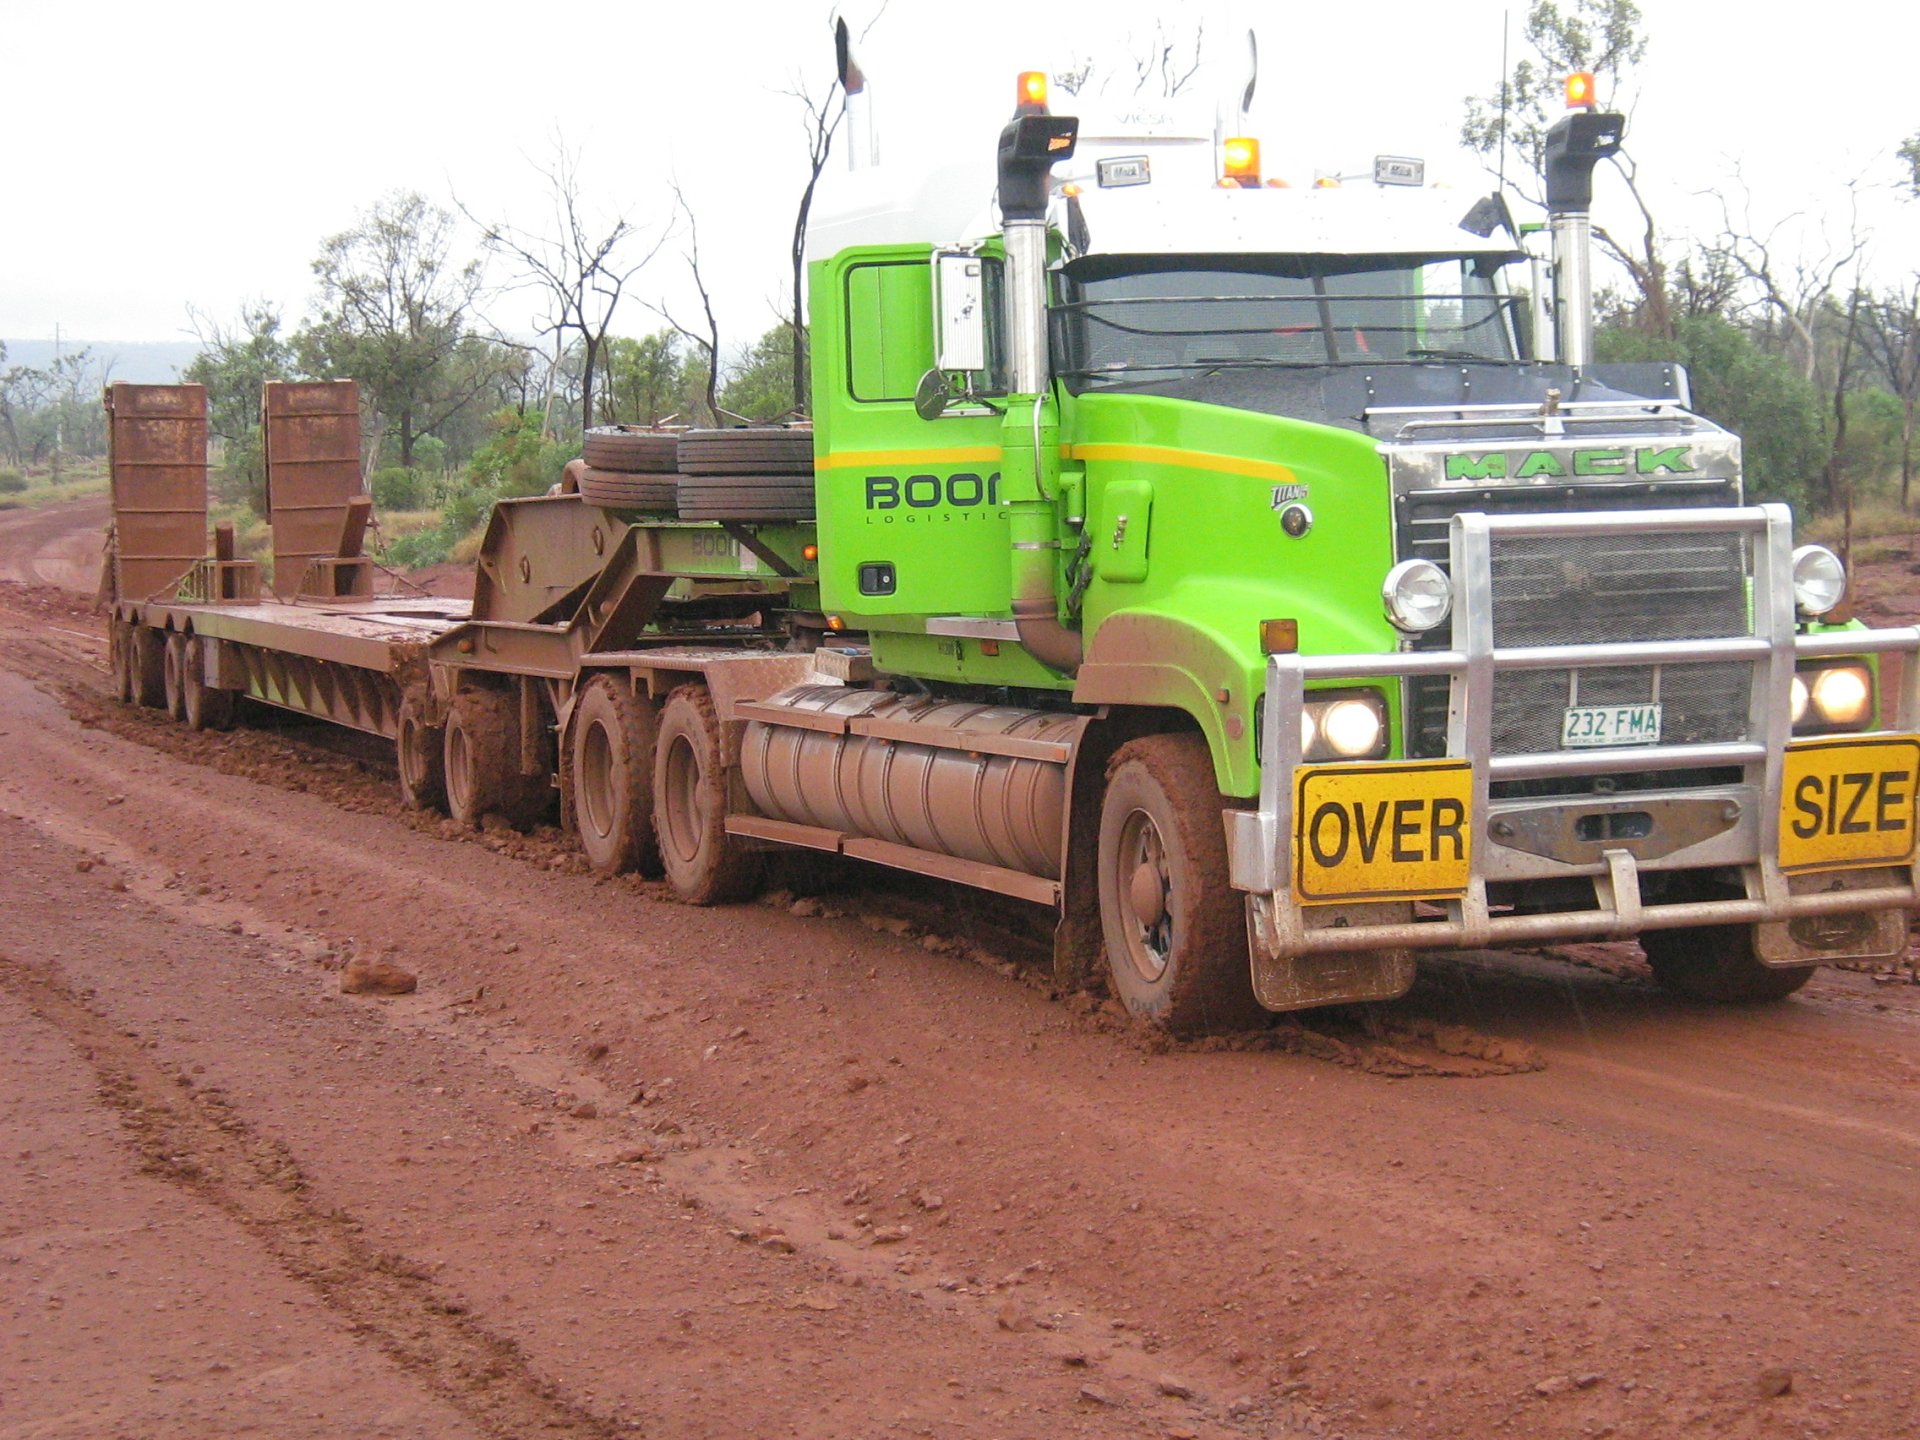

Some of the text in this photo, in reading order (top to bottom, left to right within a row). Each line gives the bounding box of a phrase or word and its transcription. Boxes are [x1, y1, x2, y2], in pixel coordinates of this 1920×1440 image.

[1445, 446, 1695, 481] MACK
[866, 511, 1008, 525] LOGISTIC
[1567, 708, 1656, 737] 232 FMA
[1792, 771, 1910, 839] SIZE
[1309, 797, 1465, 868] OVER
